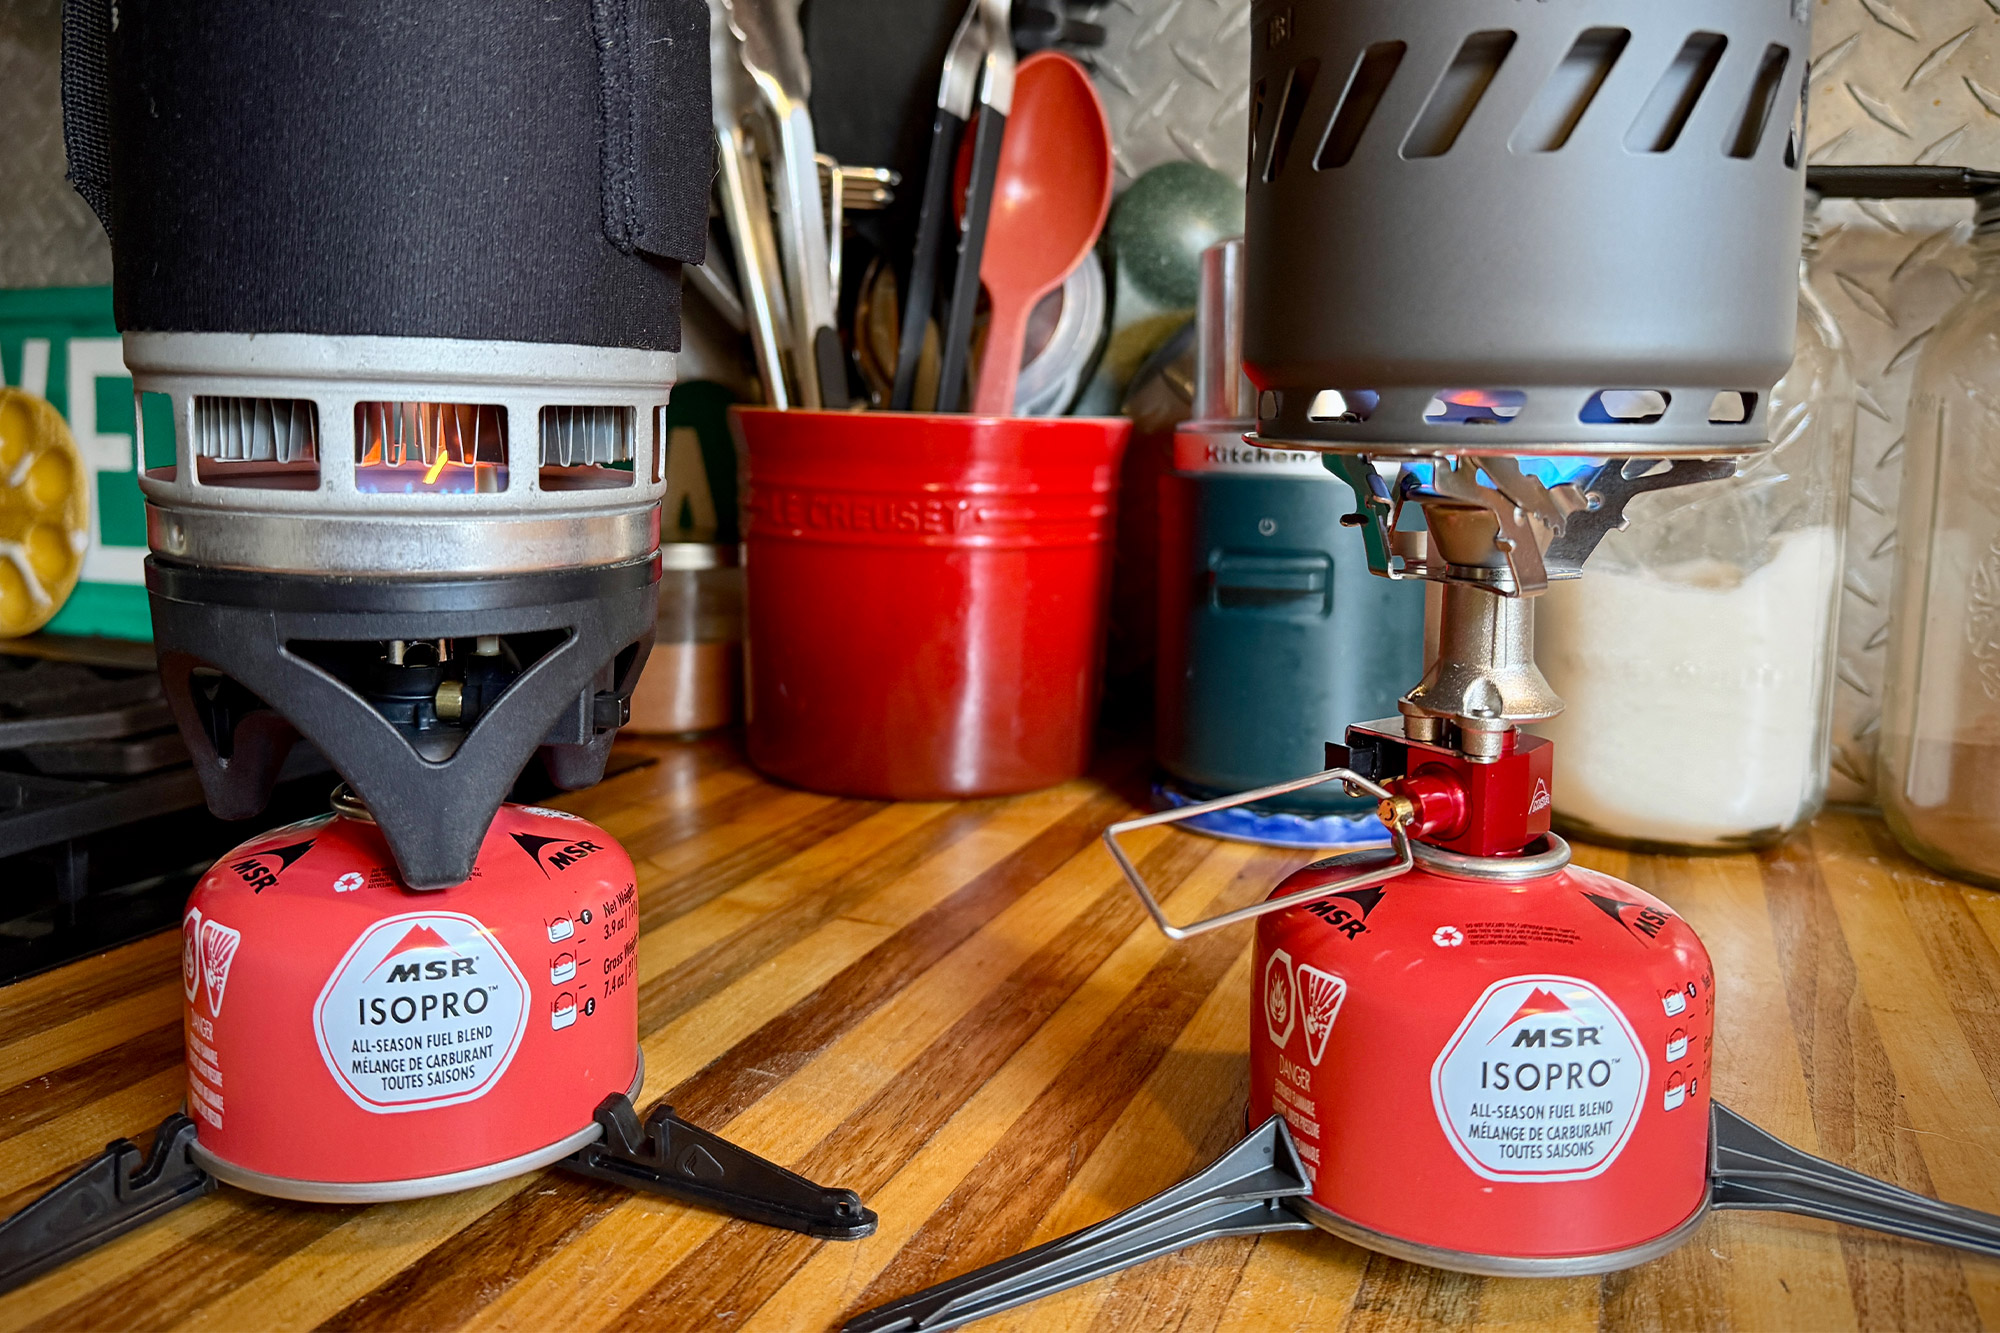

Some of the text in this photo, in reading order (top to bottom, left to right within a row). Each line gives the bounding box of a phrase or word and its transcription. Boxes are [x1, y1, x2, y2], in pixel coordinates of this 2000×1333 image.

[547, 840, 605, 871] MSR
[229, 858, 278, 895] MSR
[1301, 900, 1367, 941] MSR
[1633, 905, 1672, 939] MSR
[386, 957, 478, 983] MSR
[603, 952, 623, 975] Gross
[359, 987, 489, 1025] ISOPRO
[351, 1025, 493, 1053] ALL-SEASON FUEL BLEND
[1511, 1027, 1602, 1048] MSR
[351, 1044, 494, 1075] MÉLANGE DE CARBURANT
[1279, 1053, 1311, 1093] DANGER
[381, 1065, 476, 1091] TOUTES SAISONS
[1481, 1059, 1611, 1092] ISOPRO
[1470, 1100, 1614, 1120] ALL-SEASON FUEL BLEND
[1468, 1121, 1614, 1142] MÉLANGE DE CARBURANT
[1500, 1141, 1594, 1159] TOUTES SAISONS
